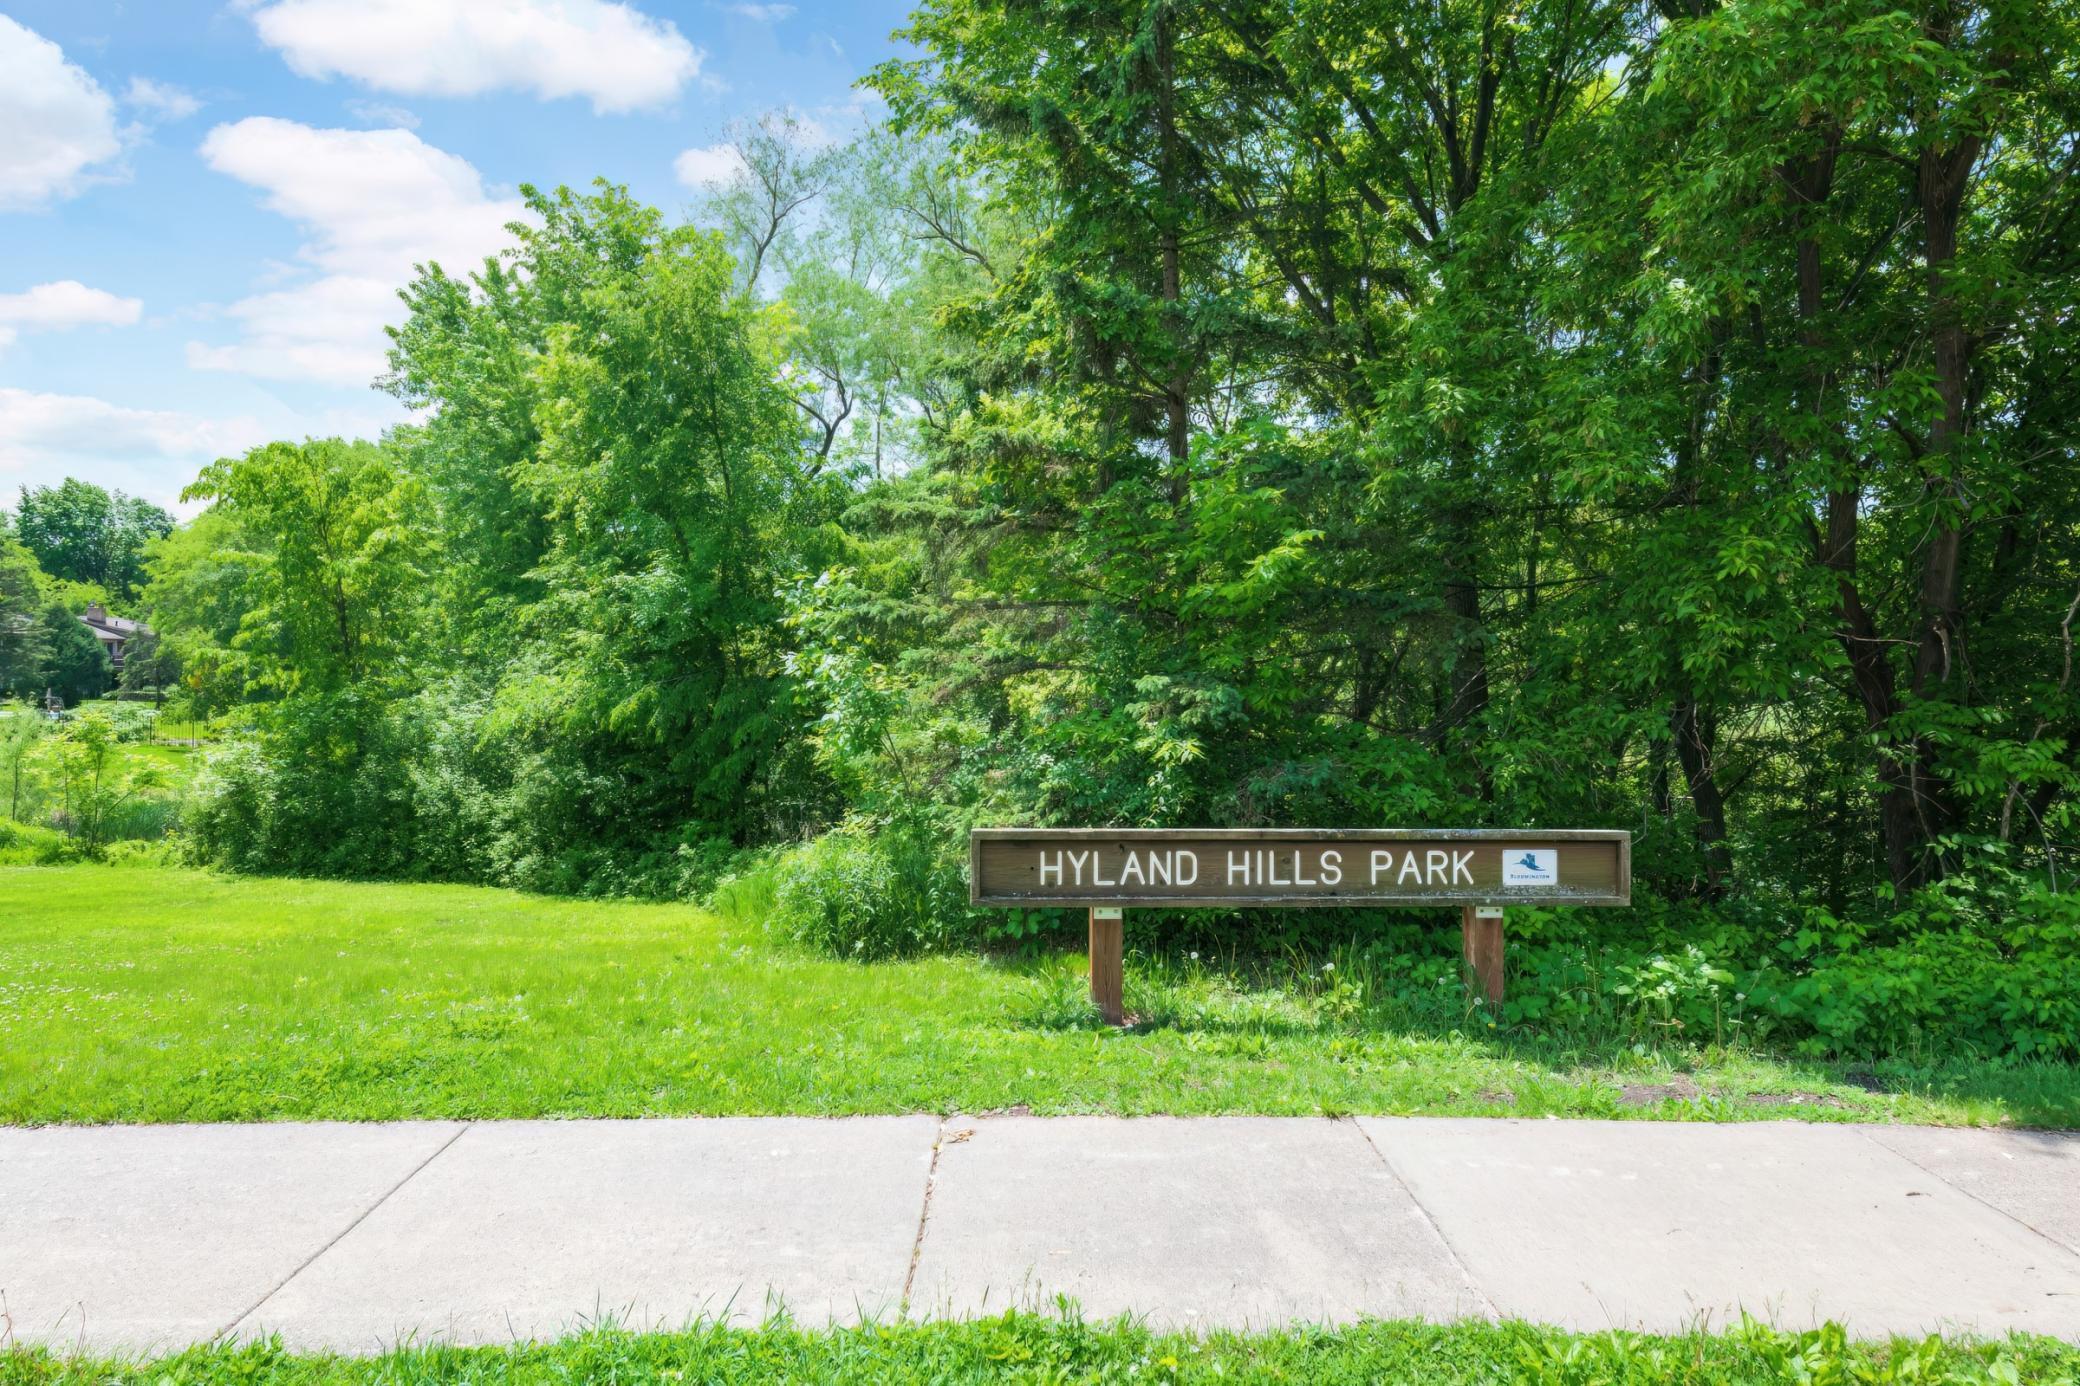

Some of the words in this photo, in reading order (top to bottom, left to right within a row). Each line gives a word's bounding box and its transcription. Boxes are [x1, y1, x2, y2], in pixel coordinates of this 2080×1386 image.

[1039, 850, 1198, 886] HYLAND
[1227, 850, 1343, 886] HILLS
[1370, 850, 1475, 886] PARK
